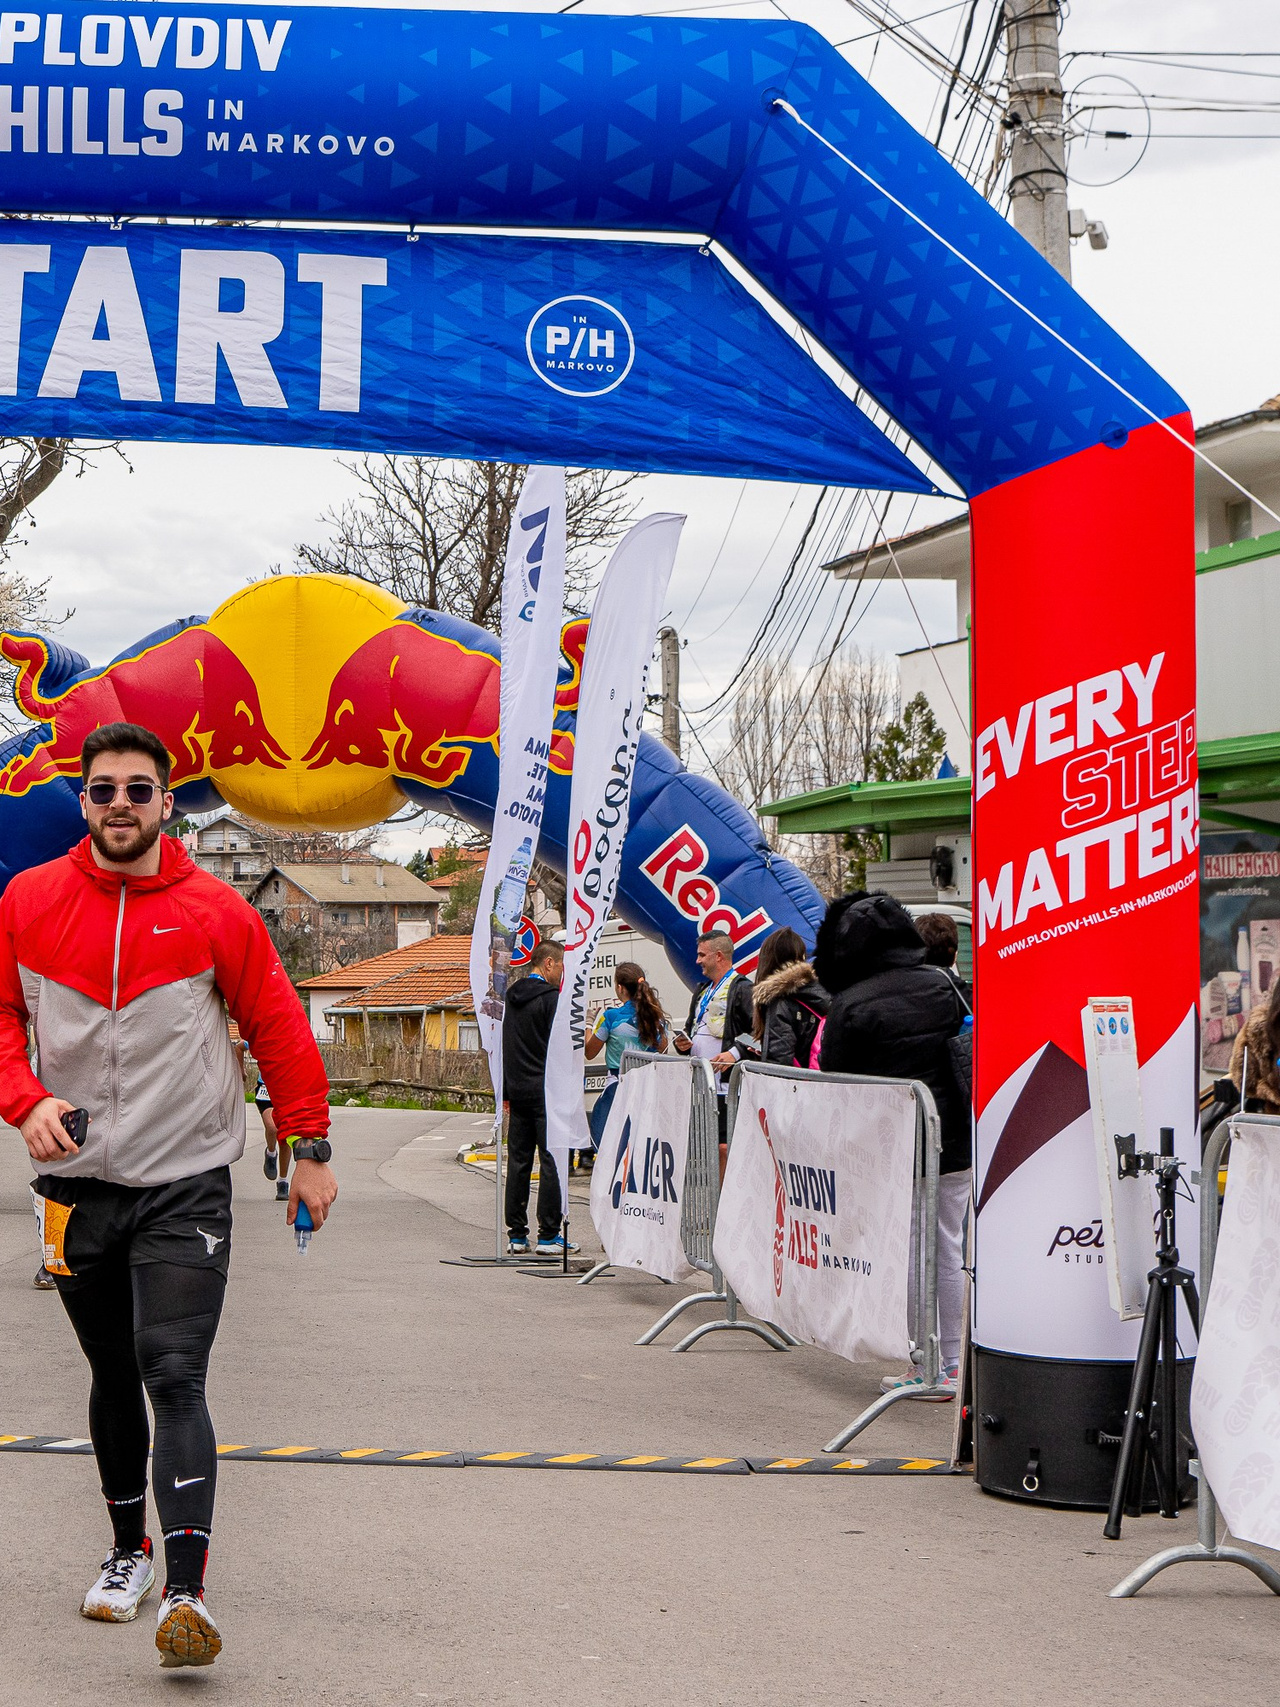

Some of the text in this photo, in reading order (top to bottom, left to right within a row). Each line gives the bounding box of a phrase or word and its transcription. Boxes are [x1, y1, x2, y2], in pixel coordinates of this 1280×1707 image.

[206, 99, 244, 121] IN
[206, 131, 396, 156] MARKOVO
[573, 315, 587, 324] IN
[546, 325, 615, 359] P/H
[546, 360, 615, 373] MARKOVO
[976, 651, 1165, 802] EVERY
[1061, 708, 1197, 829] STEP
[642, 826, 772, 946] Red
[997, 869, 1197, 960] WWW.PLOVDIV-HILLS-IN-MARKOVO.COM
[589, 976, 612, 989] FEN
[821, 1233, 831, 1247] IN
